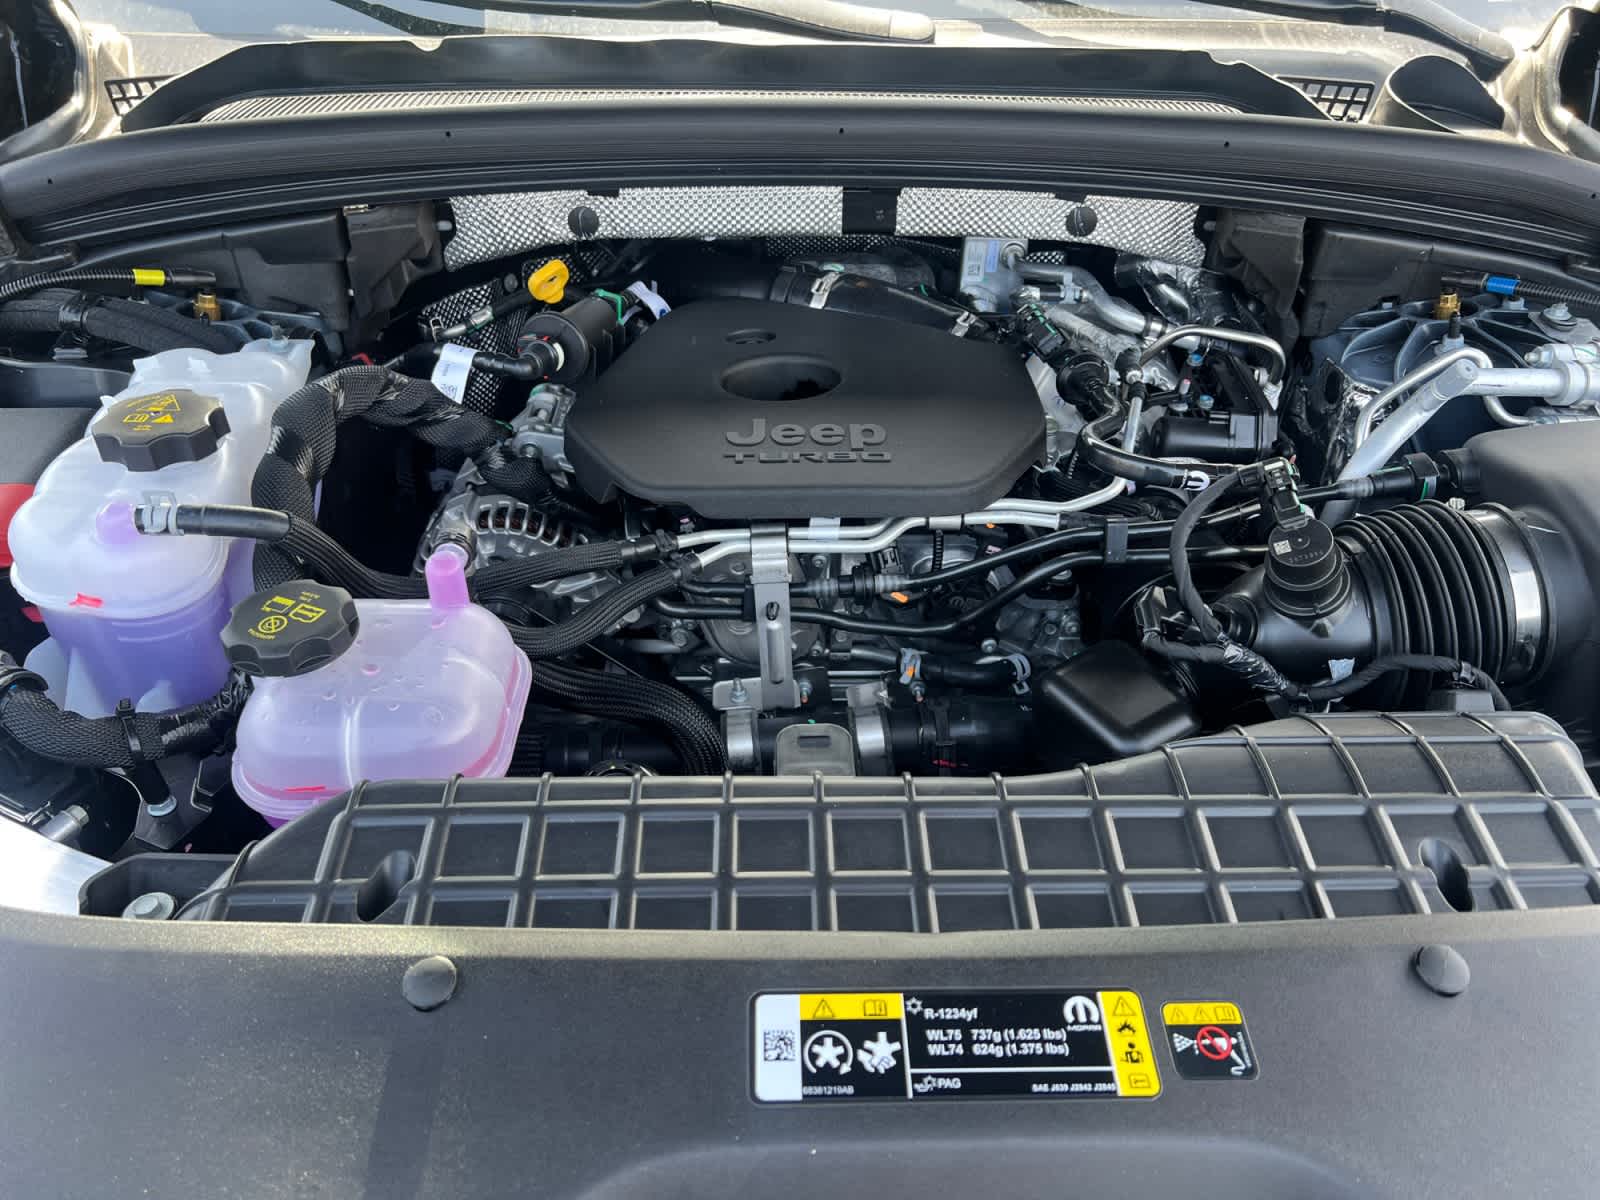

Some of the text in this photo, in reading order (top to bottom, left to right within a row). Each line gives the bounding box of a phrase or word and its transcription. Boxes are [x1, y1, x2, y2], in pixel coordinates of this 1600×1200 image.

[724, 417, 888, 452] Jeep
[722, 450, 893, 465] TURBO
[923, 1007, 979, 1022] R-1234yf
[925, 1027, 1068, 1044] WL75 737g (1.625 lbs)
[927, 1042, 1070, 1058] WL74 624g (1.375 lbs)
[937, 1077, 962, 1090] PAG
